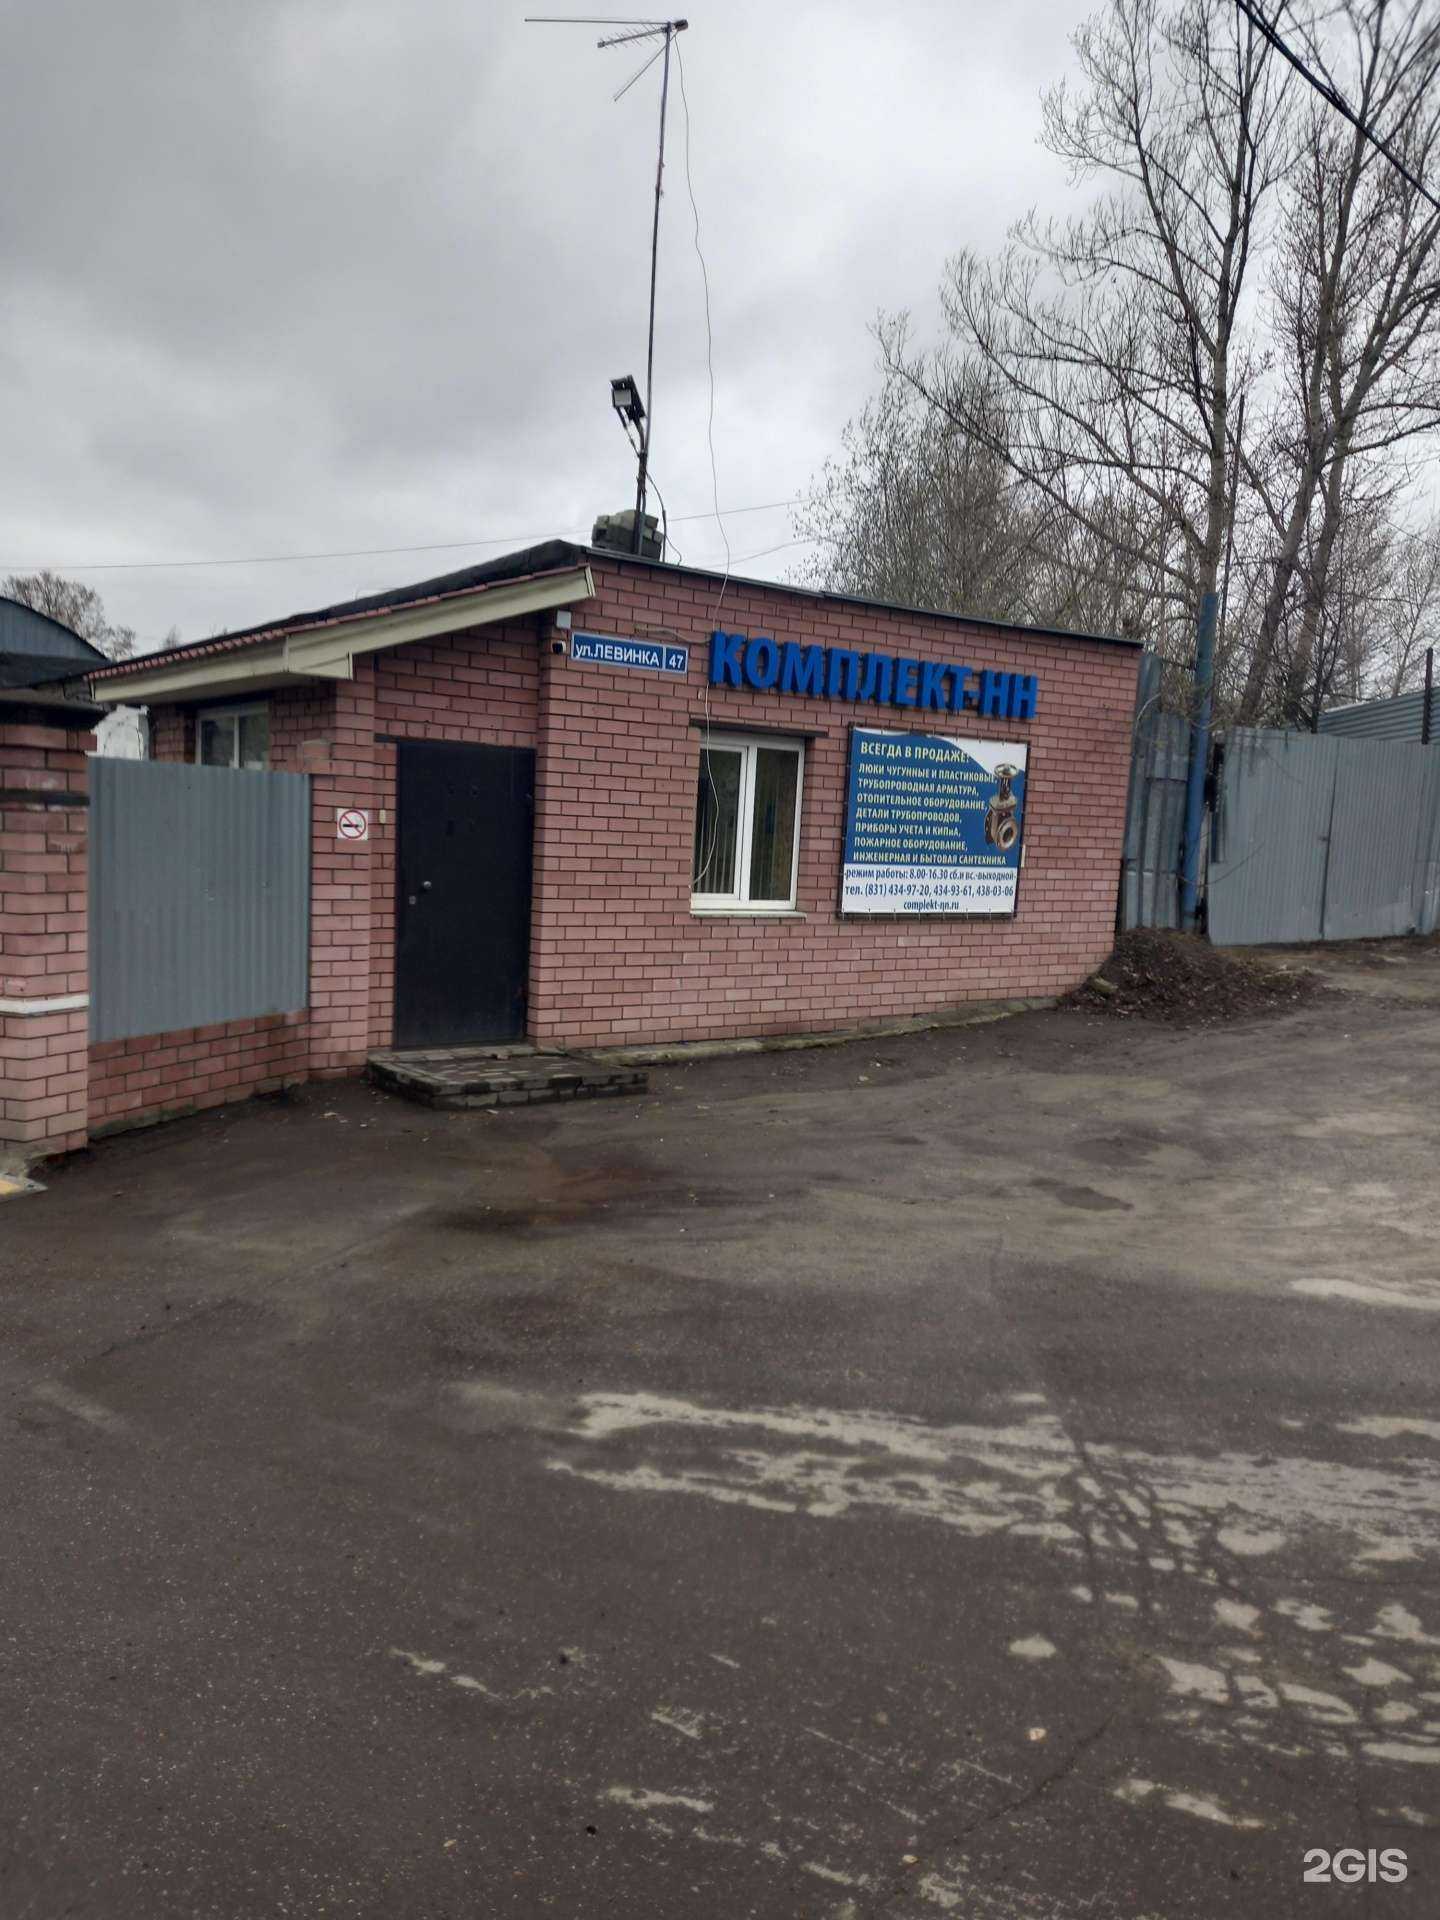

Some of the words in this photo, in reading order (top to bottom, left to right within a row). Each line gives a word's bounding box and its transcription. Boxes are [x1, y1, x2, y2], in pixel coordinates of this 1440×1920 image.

[669, 654, 684, 669] 47
[709, 631, 1038, 720] КОМПЛЕКТ-НН
[861, 741, 902, 759] ВСЕГДА
[905, 746, 912, 758] В
[859, 763, 884, 773] ЛЮКИ
[886, 765, 929, 778] ЧУГУННЫЕ
[932, 769, 937, 779] И
[939, 769, 997, 784] ПЛАСТИКОВЫЕ,
[858, 778, 935, 793] ТРУБОПРОВОДНАЯ
[936, 784, 979, 797] АРМАТУРА,
[857, 792, 921, 806] ОТОПИТЕЛЬНОЕ
[924, 797, 988, 812] ОБОРУДОВАНИЕ,
[855, 807, 889, 820] ДЕТАЛИ
[891, 809, 962, 824] ТРУБОПРОВОДОВ,
[856, 822, 897, 833] ПРИБОРЫ
[899, 824, 923, 835] УЧЕТА
[925, 825, 930, 835] И
[854, 837, 900, 848] ПОЖАРНОЕ
[903, 839, 968, 851] ОБОРУДОВАНИЕ,
[853, 851, 911, 863] ИНЖЕНЕРНАЯ
[913, 853, 918, 863] И
[920, 854, 957, 865] БЫТОВАЯ
[959, 855, 1006, 865] САНТЕХНИКА
[876, 867, 908, 881] работы:
[910, 869, 948, 880] 8.00-16.30
[845, 885, 863, 895] тел.
[865, 882, 887, 897] (831)
[889, 884, 931, 897] 434-97-20,
[934, 885, 974, 898] 434-93-61,
[977, 886, 1013, 897] 438-03-06
[903, 897, 959, 911] complekt-nn.ru
